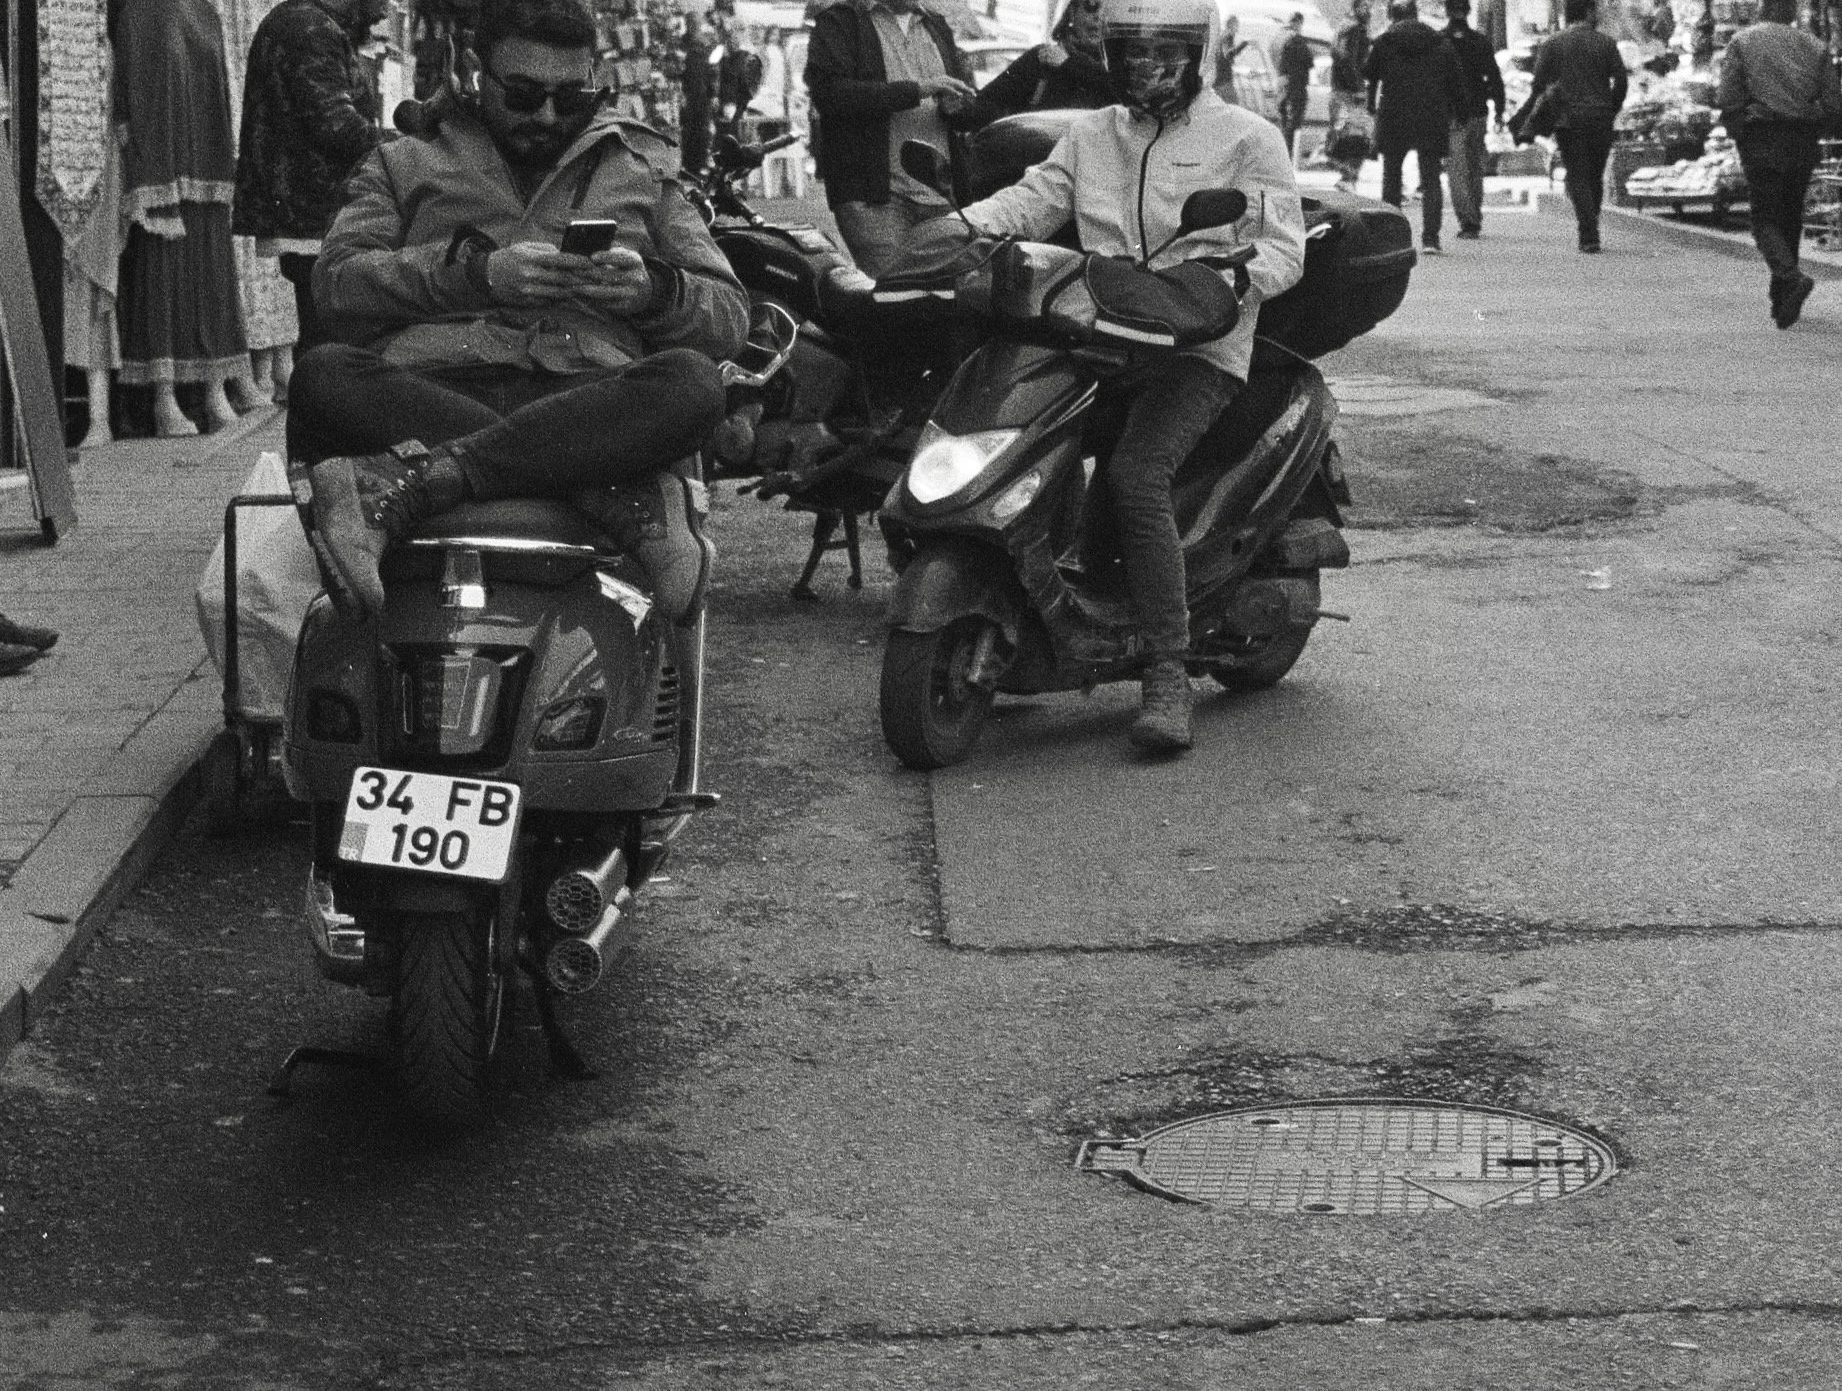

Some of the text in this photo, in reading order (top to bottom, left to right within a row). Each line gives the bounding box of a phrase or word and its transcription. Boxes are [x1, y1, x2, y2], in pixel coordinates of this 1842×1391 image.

[356, 770, 514, 827] 34 FB
[339, 845, 359, 861] TR
[390, 822, 471, 871] 190
